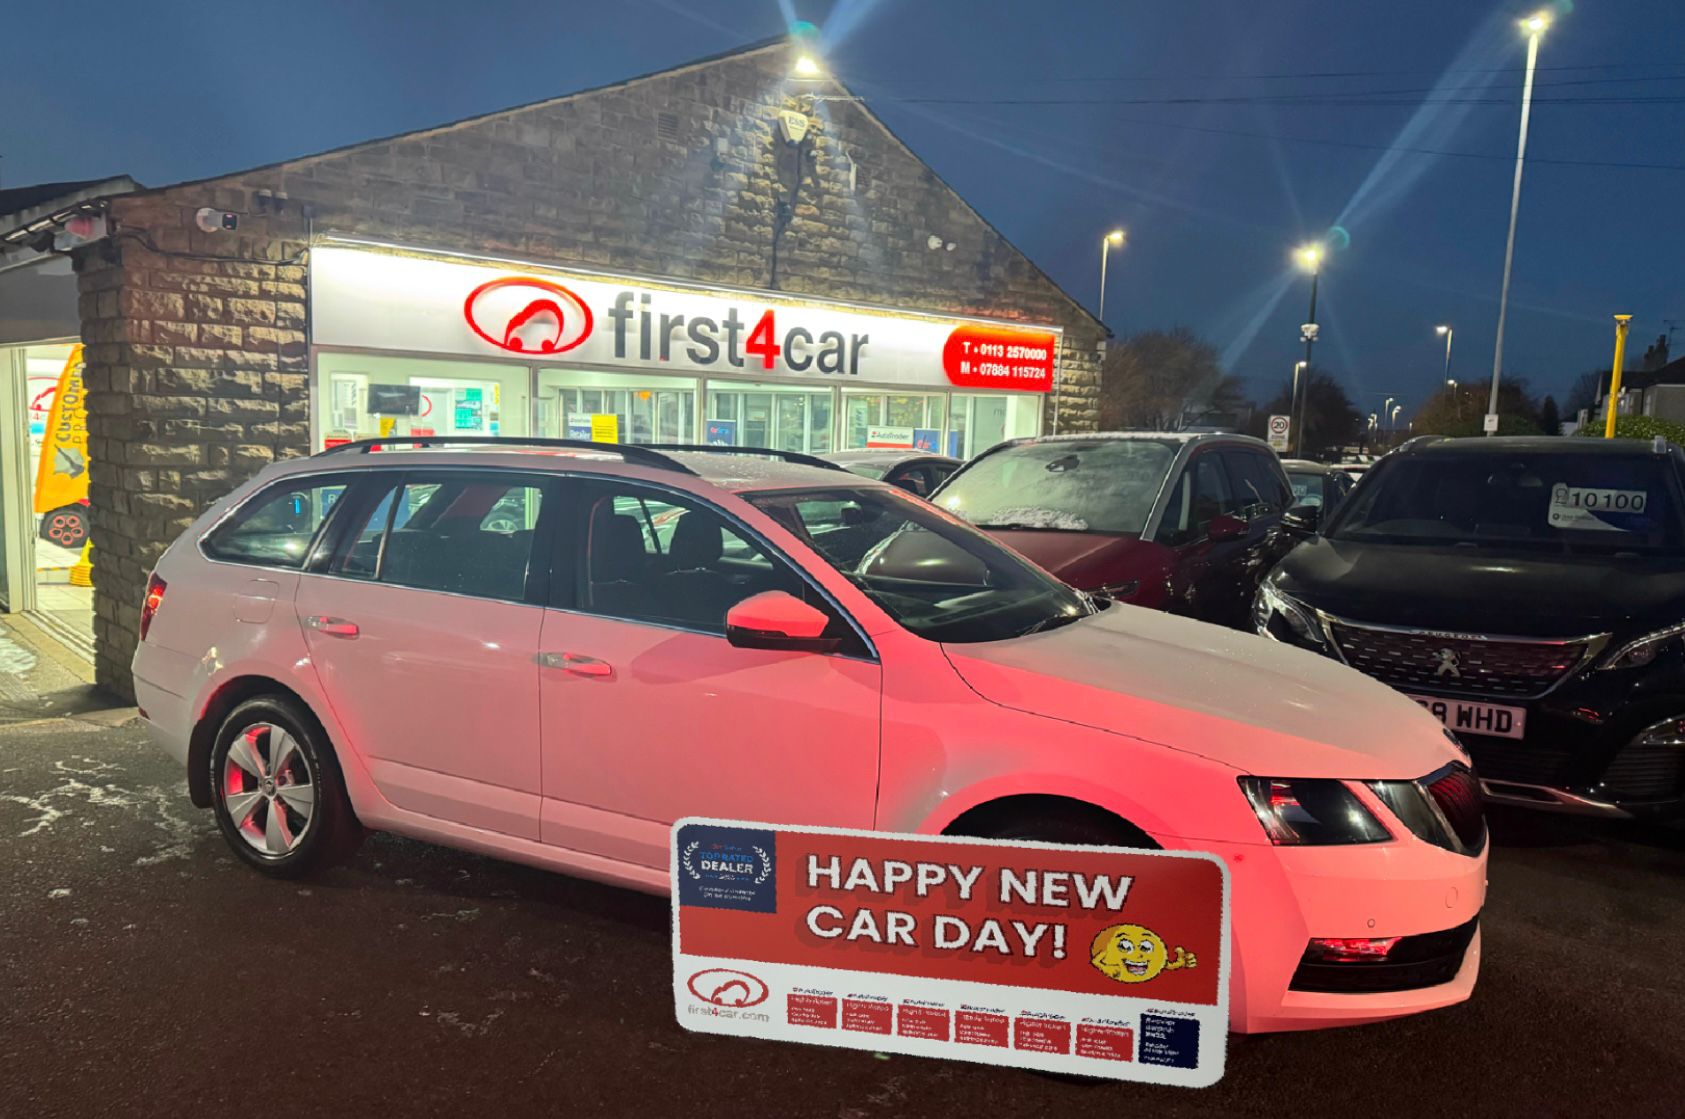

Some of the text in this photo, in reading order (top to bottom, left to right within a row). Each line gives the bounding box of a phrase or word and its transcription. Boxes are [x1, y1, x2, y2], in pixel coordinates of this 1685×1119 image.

[608, 291, 869, 375] first4car
[962, 342, 971, 354] T
[980, 343, 1004, 357] 0113
[960, 361, 970, 375] M
[1012, 365, 1046, 379] 115724
[1273, 421, 1285, 429] 20
[1457, 704, 1512, 733] WHD
[701, 860, 754, 875] DEALER
[808, 854, 1134, 911] HAPPY NEW
[806, 905, 1067, 959] CAR DAY!
[688, 1004, 770, 1022] first4car.com
